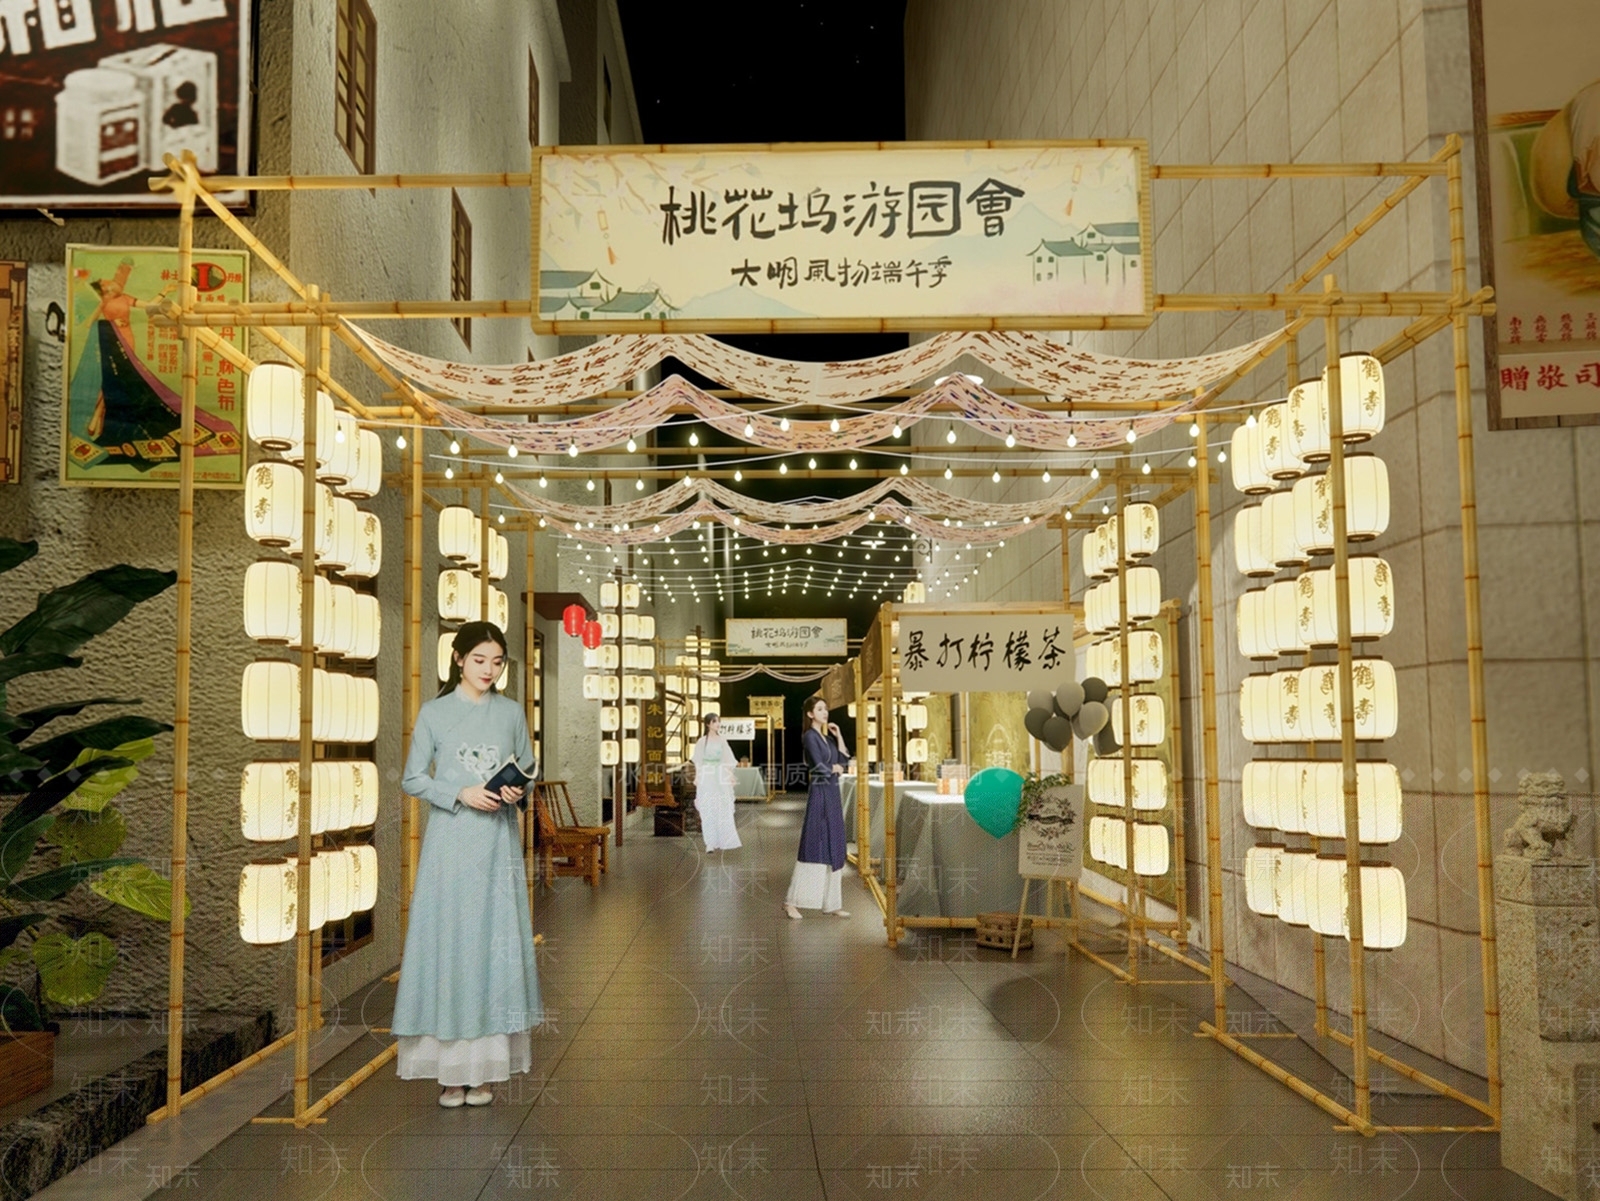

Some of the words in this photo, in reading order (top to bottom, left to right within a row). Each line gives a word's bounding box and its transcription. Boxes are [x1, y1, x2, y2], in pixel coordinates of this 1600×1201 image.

[903, 626, 1067, 672] 暴打柠檬茶
